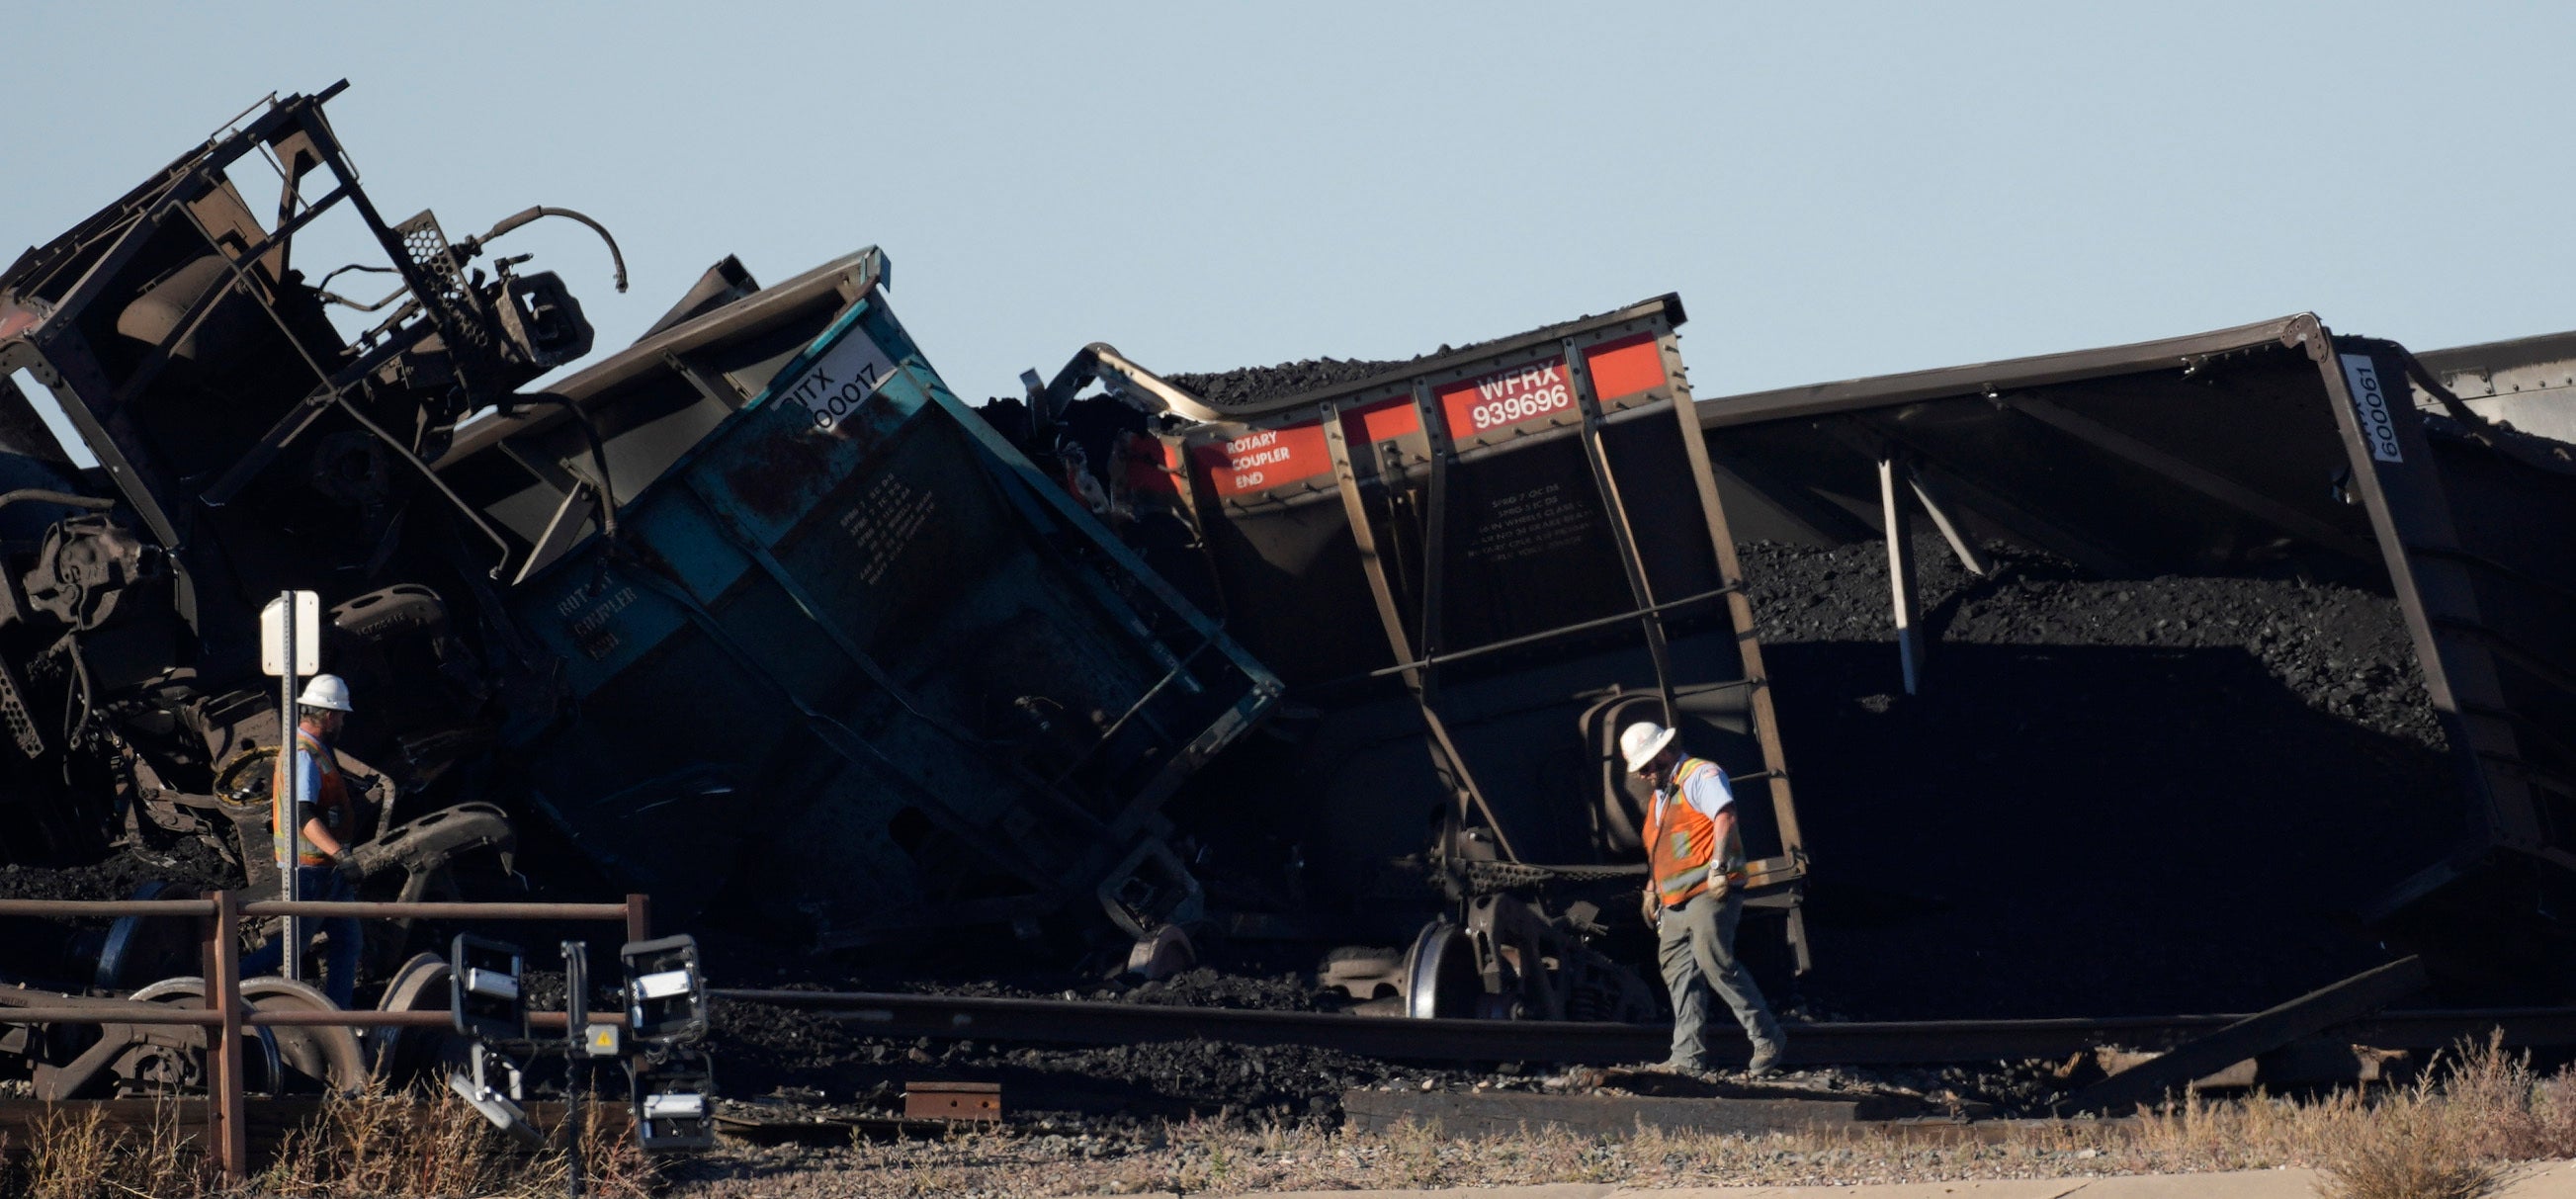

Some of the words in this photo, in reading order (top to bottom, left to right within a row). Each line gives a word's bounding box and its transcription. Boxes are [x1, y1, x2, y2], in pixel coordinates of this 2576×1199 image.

[782, 367, 834, 407] ITX
[1477, 360, 1560, 400] WFRX
[1473, 384, 1569, 428] 939696
[2357, 367, 2398, 457] 600061
[1227, 430, 1277, 454] ROTARY
[1232, 447, 1290, 471] COUPLER
[1236, 471, 1264, 488] END
[557, 570, 613, 617] ROTY
